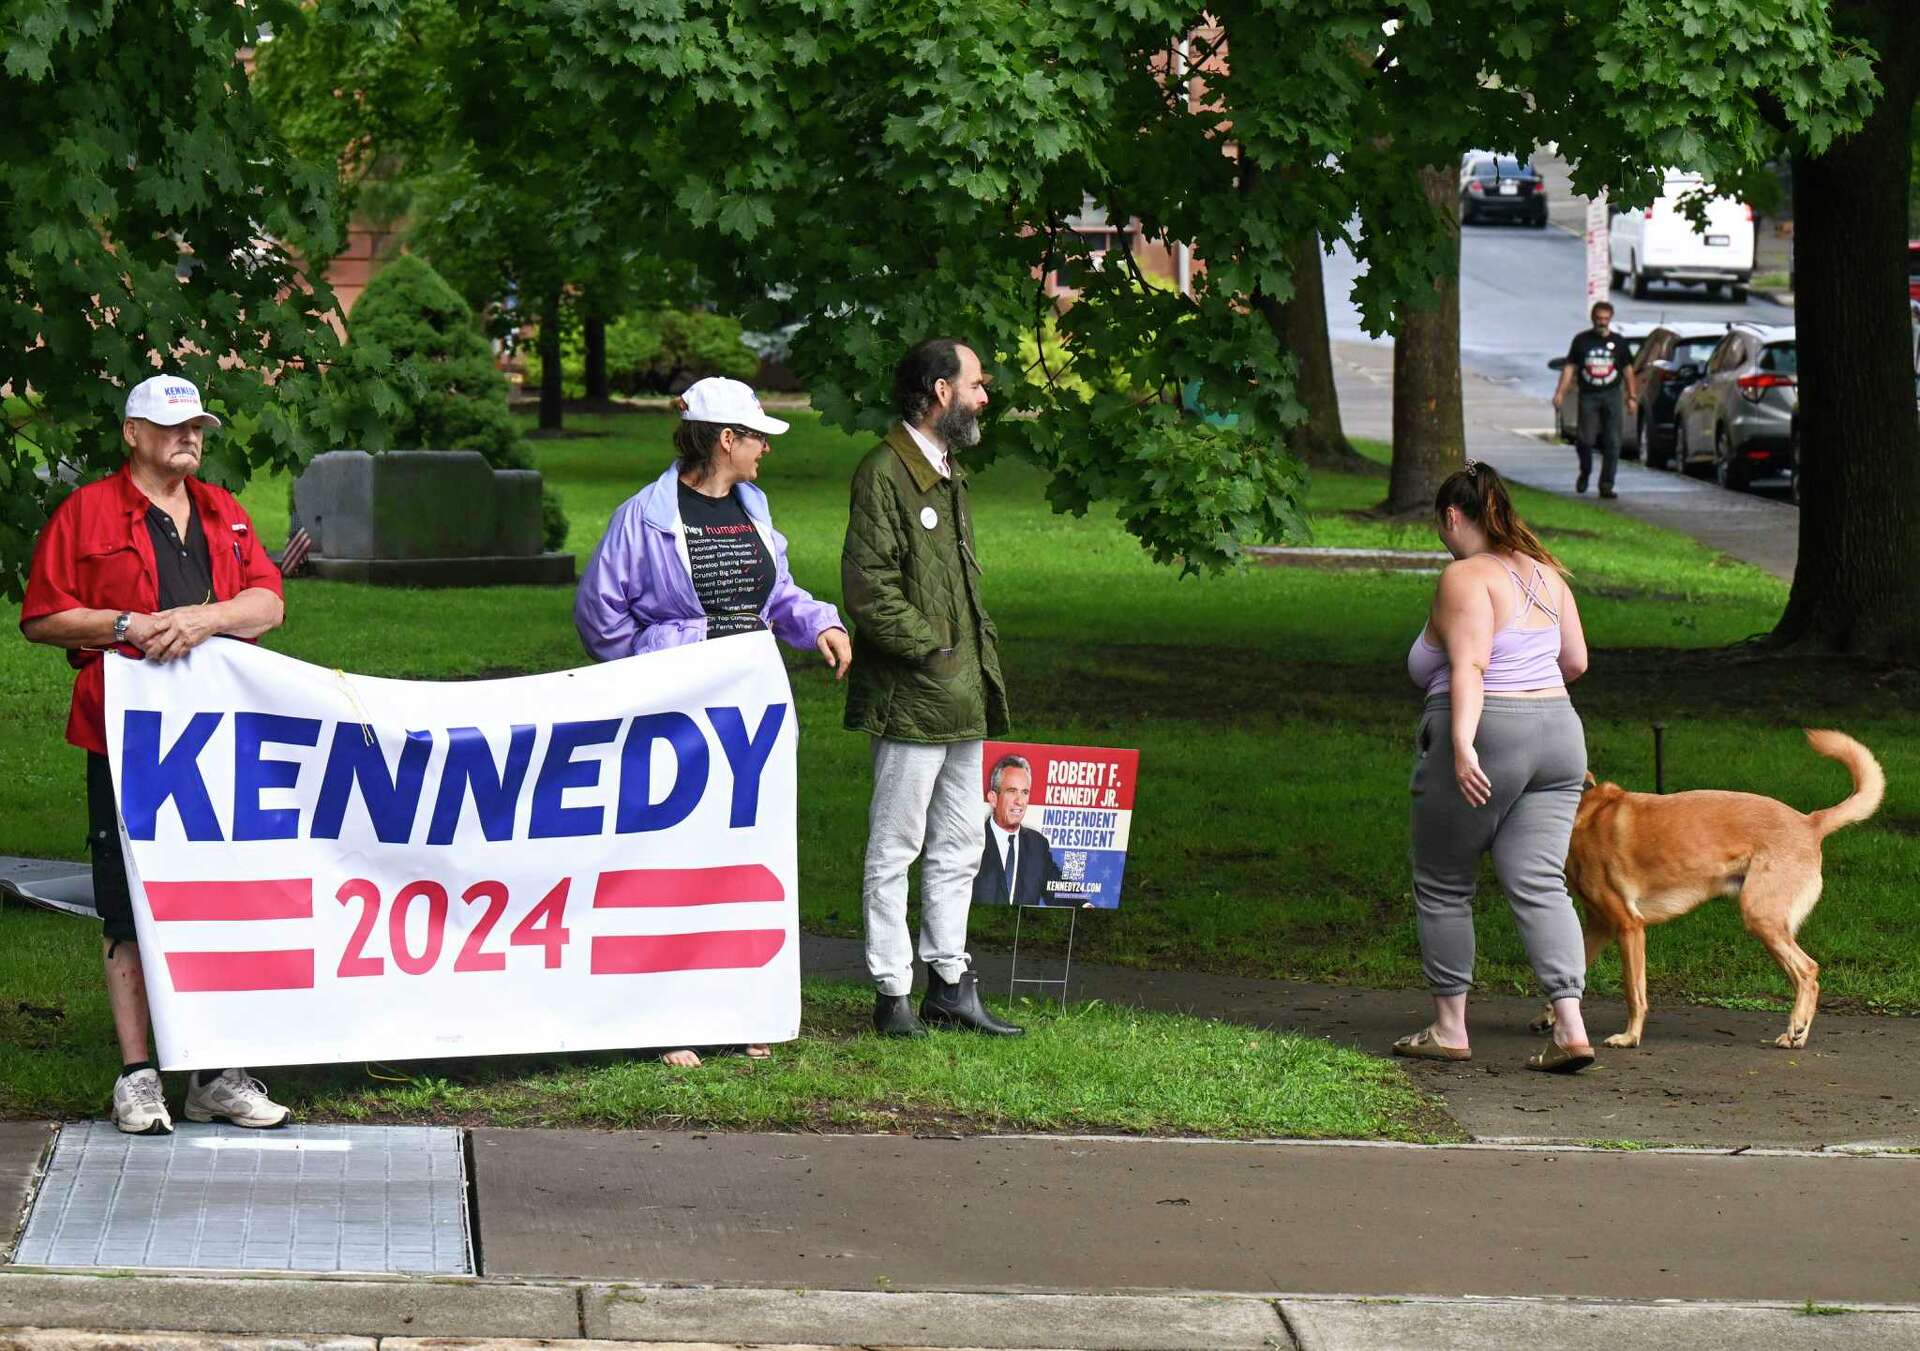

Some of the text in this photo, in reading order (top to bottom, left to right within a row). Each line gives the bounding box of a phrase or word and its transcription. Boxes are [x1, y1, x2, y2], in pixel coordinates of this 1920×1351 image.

[684, 524, 703, 535] hey
[121, 703, 787, 846] KENNEDY
[1047, 760, 1122, 788] ROBERT F.
[1045, 786, 1120, 808] KENNEDY JR.
[1042, 809, 1118, 829] INDEPENDENT
[1050, 829, 1115, 848] PRESIDENT
[1046, 881, 1102, 893] KENNEDY24.COM
[335, 876, 572, 978] 2024
